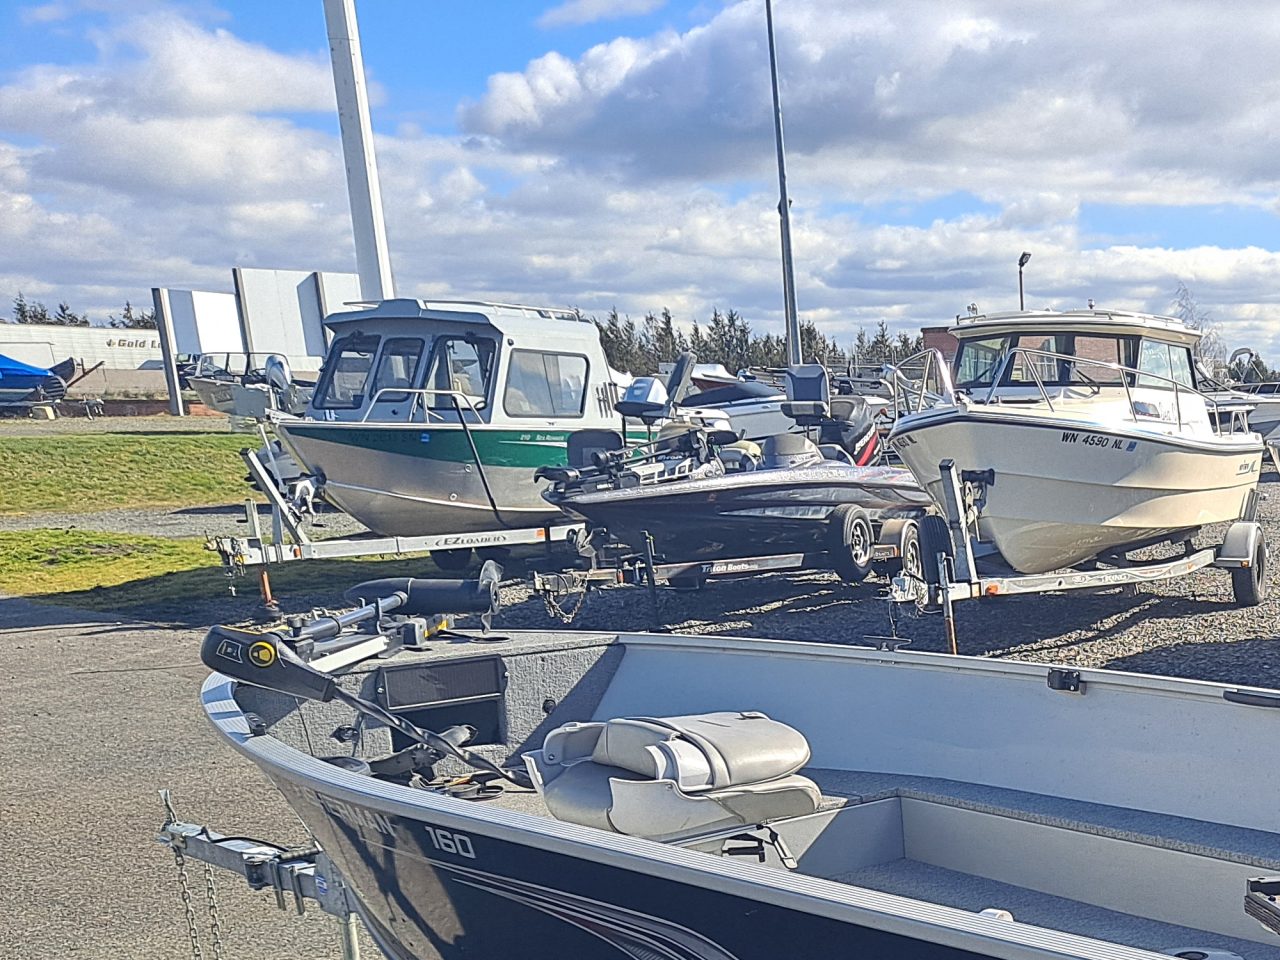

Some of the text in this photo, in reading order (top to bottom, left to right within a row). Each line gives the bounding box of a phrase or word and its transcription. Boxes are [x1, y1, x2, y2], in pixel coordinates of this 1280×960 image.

[117, 339, 147, 348] Gold
[1061, 431, 1124, 450] WN 4590 NL
[701, 563, 727, 573] Triton
[425, 826, 477, 860] 160
